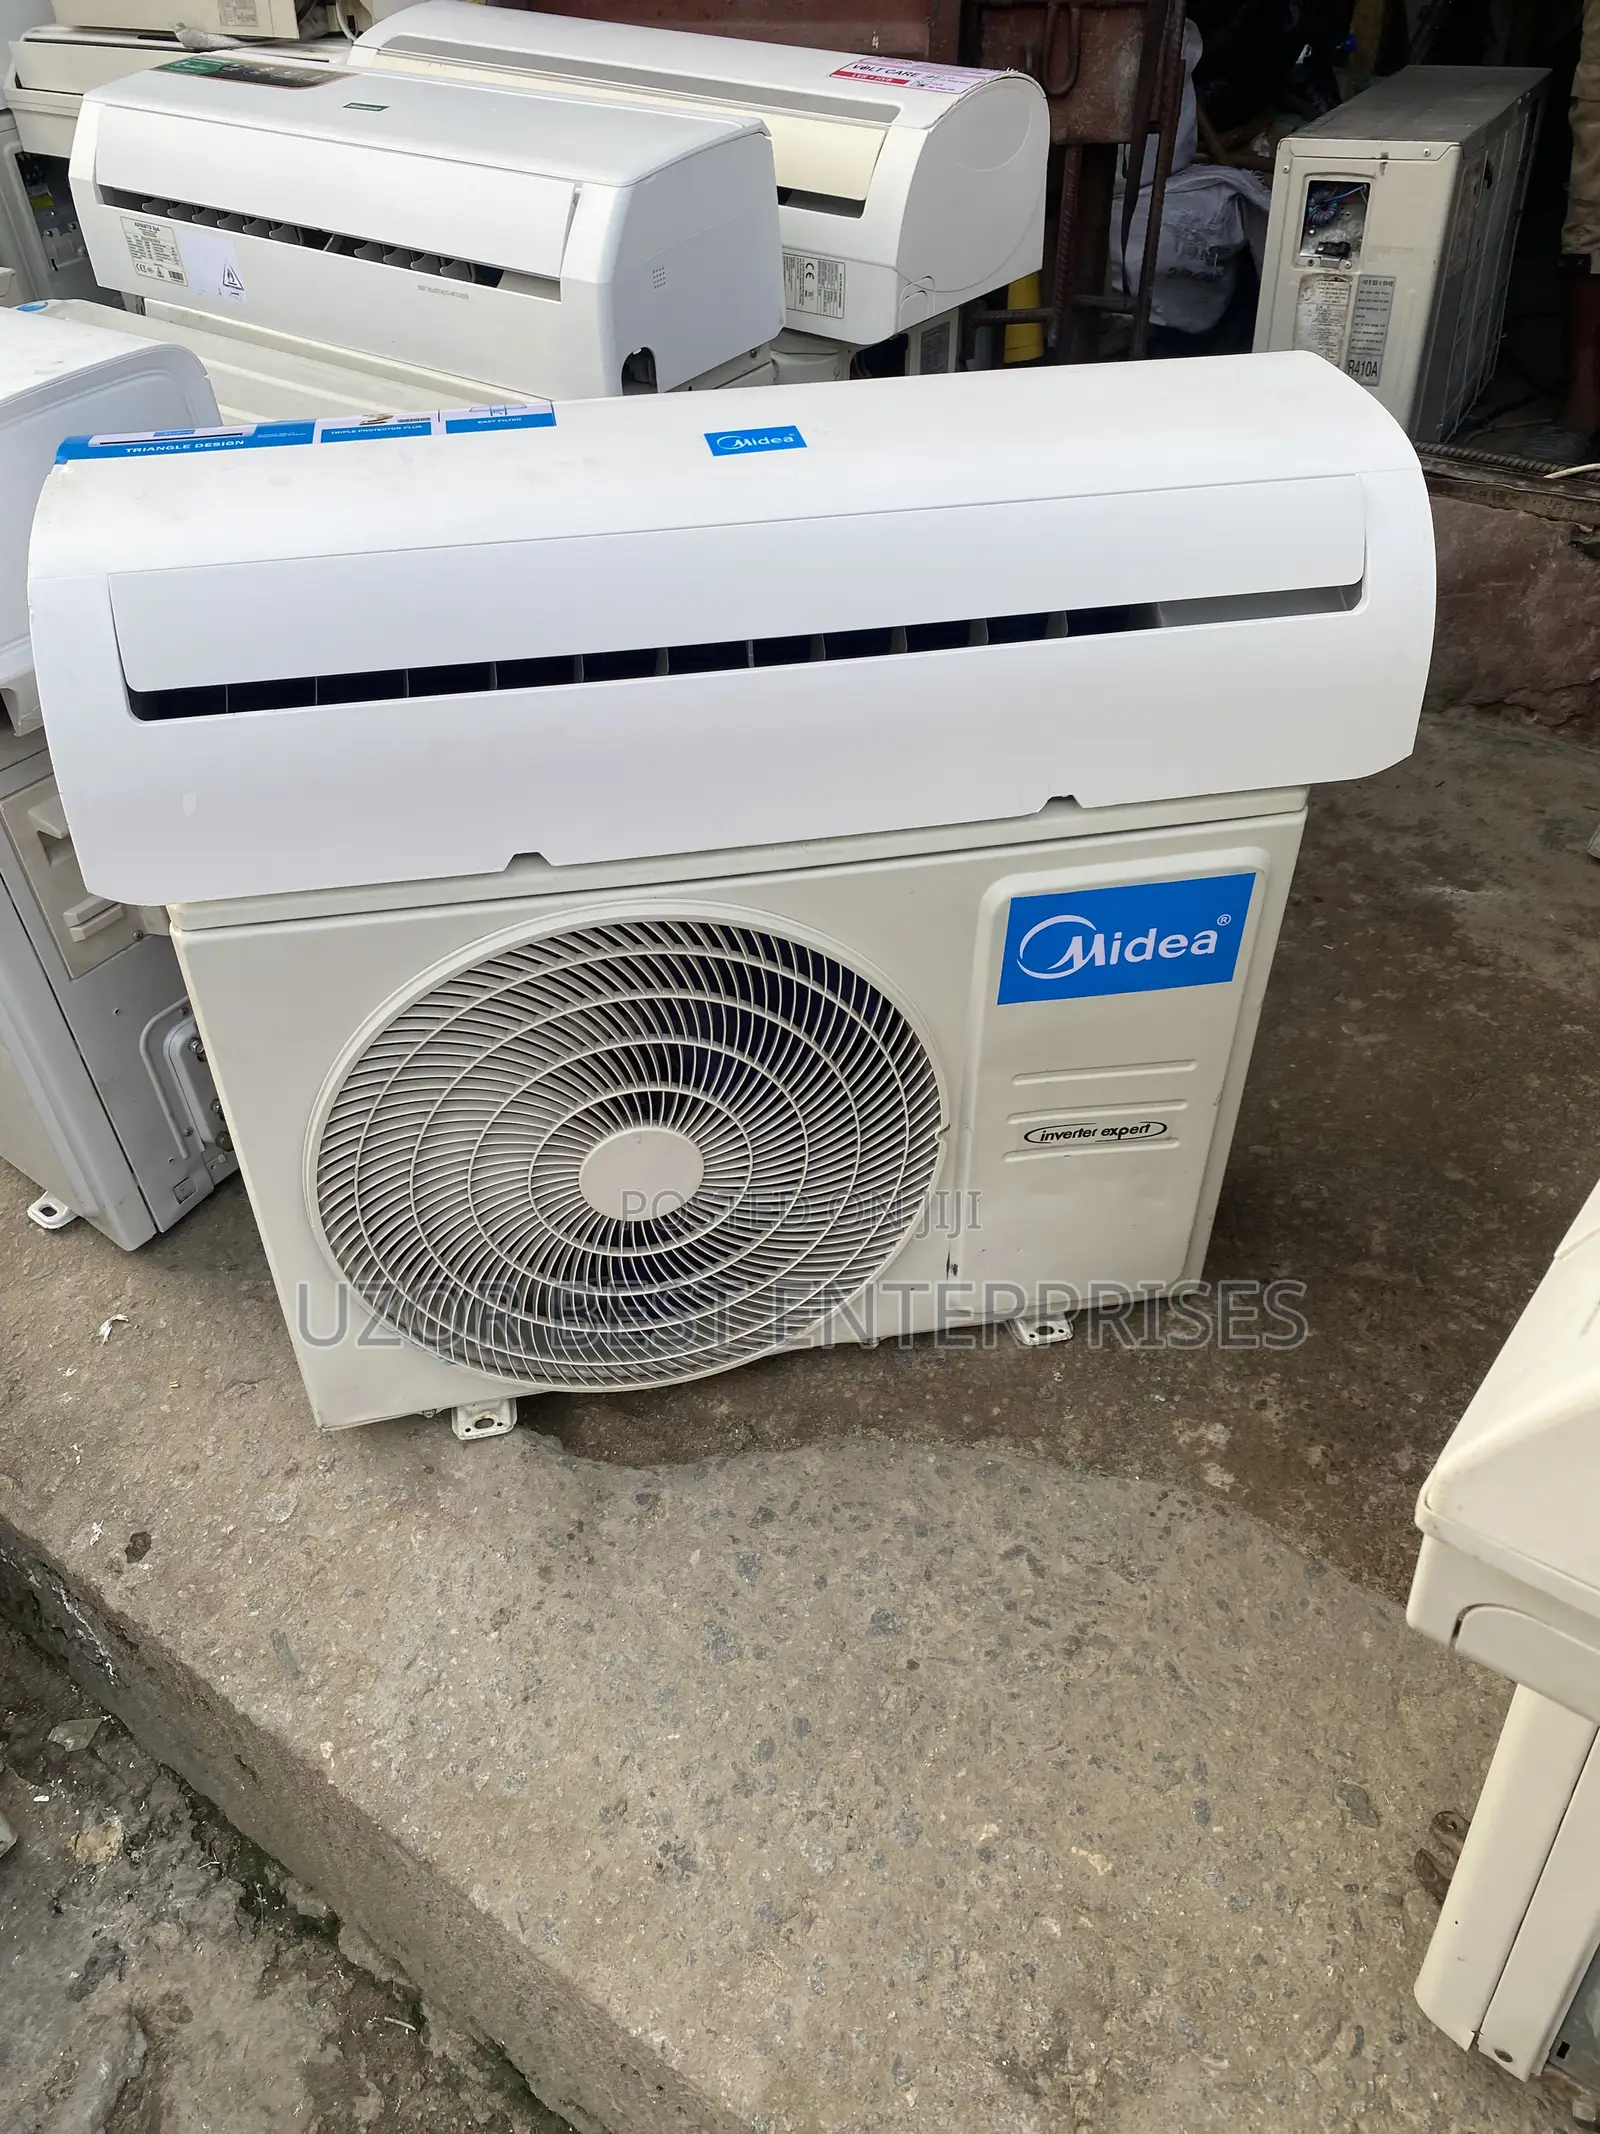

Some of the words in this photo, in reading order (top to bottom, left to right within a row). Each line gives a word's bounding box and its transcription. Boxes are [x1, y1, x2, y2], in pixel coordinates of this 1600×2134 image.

[884, 68, 921, 77] CARE
[1347, 359, 1378, 377] R410A
[125, 444, 191, 453] TRIANGLE
[194, 440, 244, 449] DESIGN
[717, 435, 794, 450] Midea
[1040, 1128, 1098, 1142] inverter
[1101, 1123, 1151, 1140] expert
